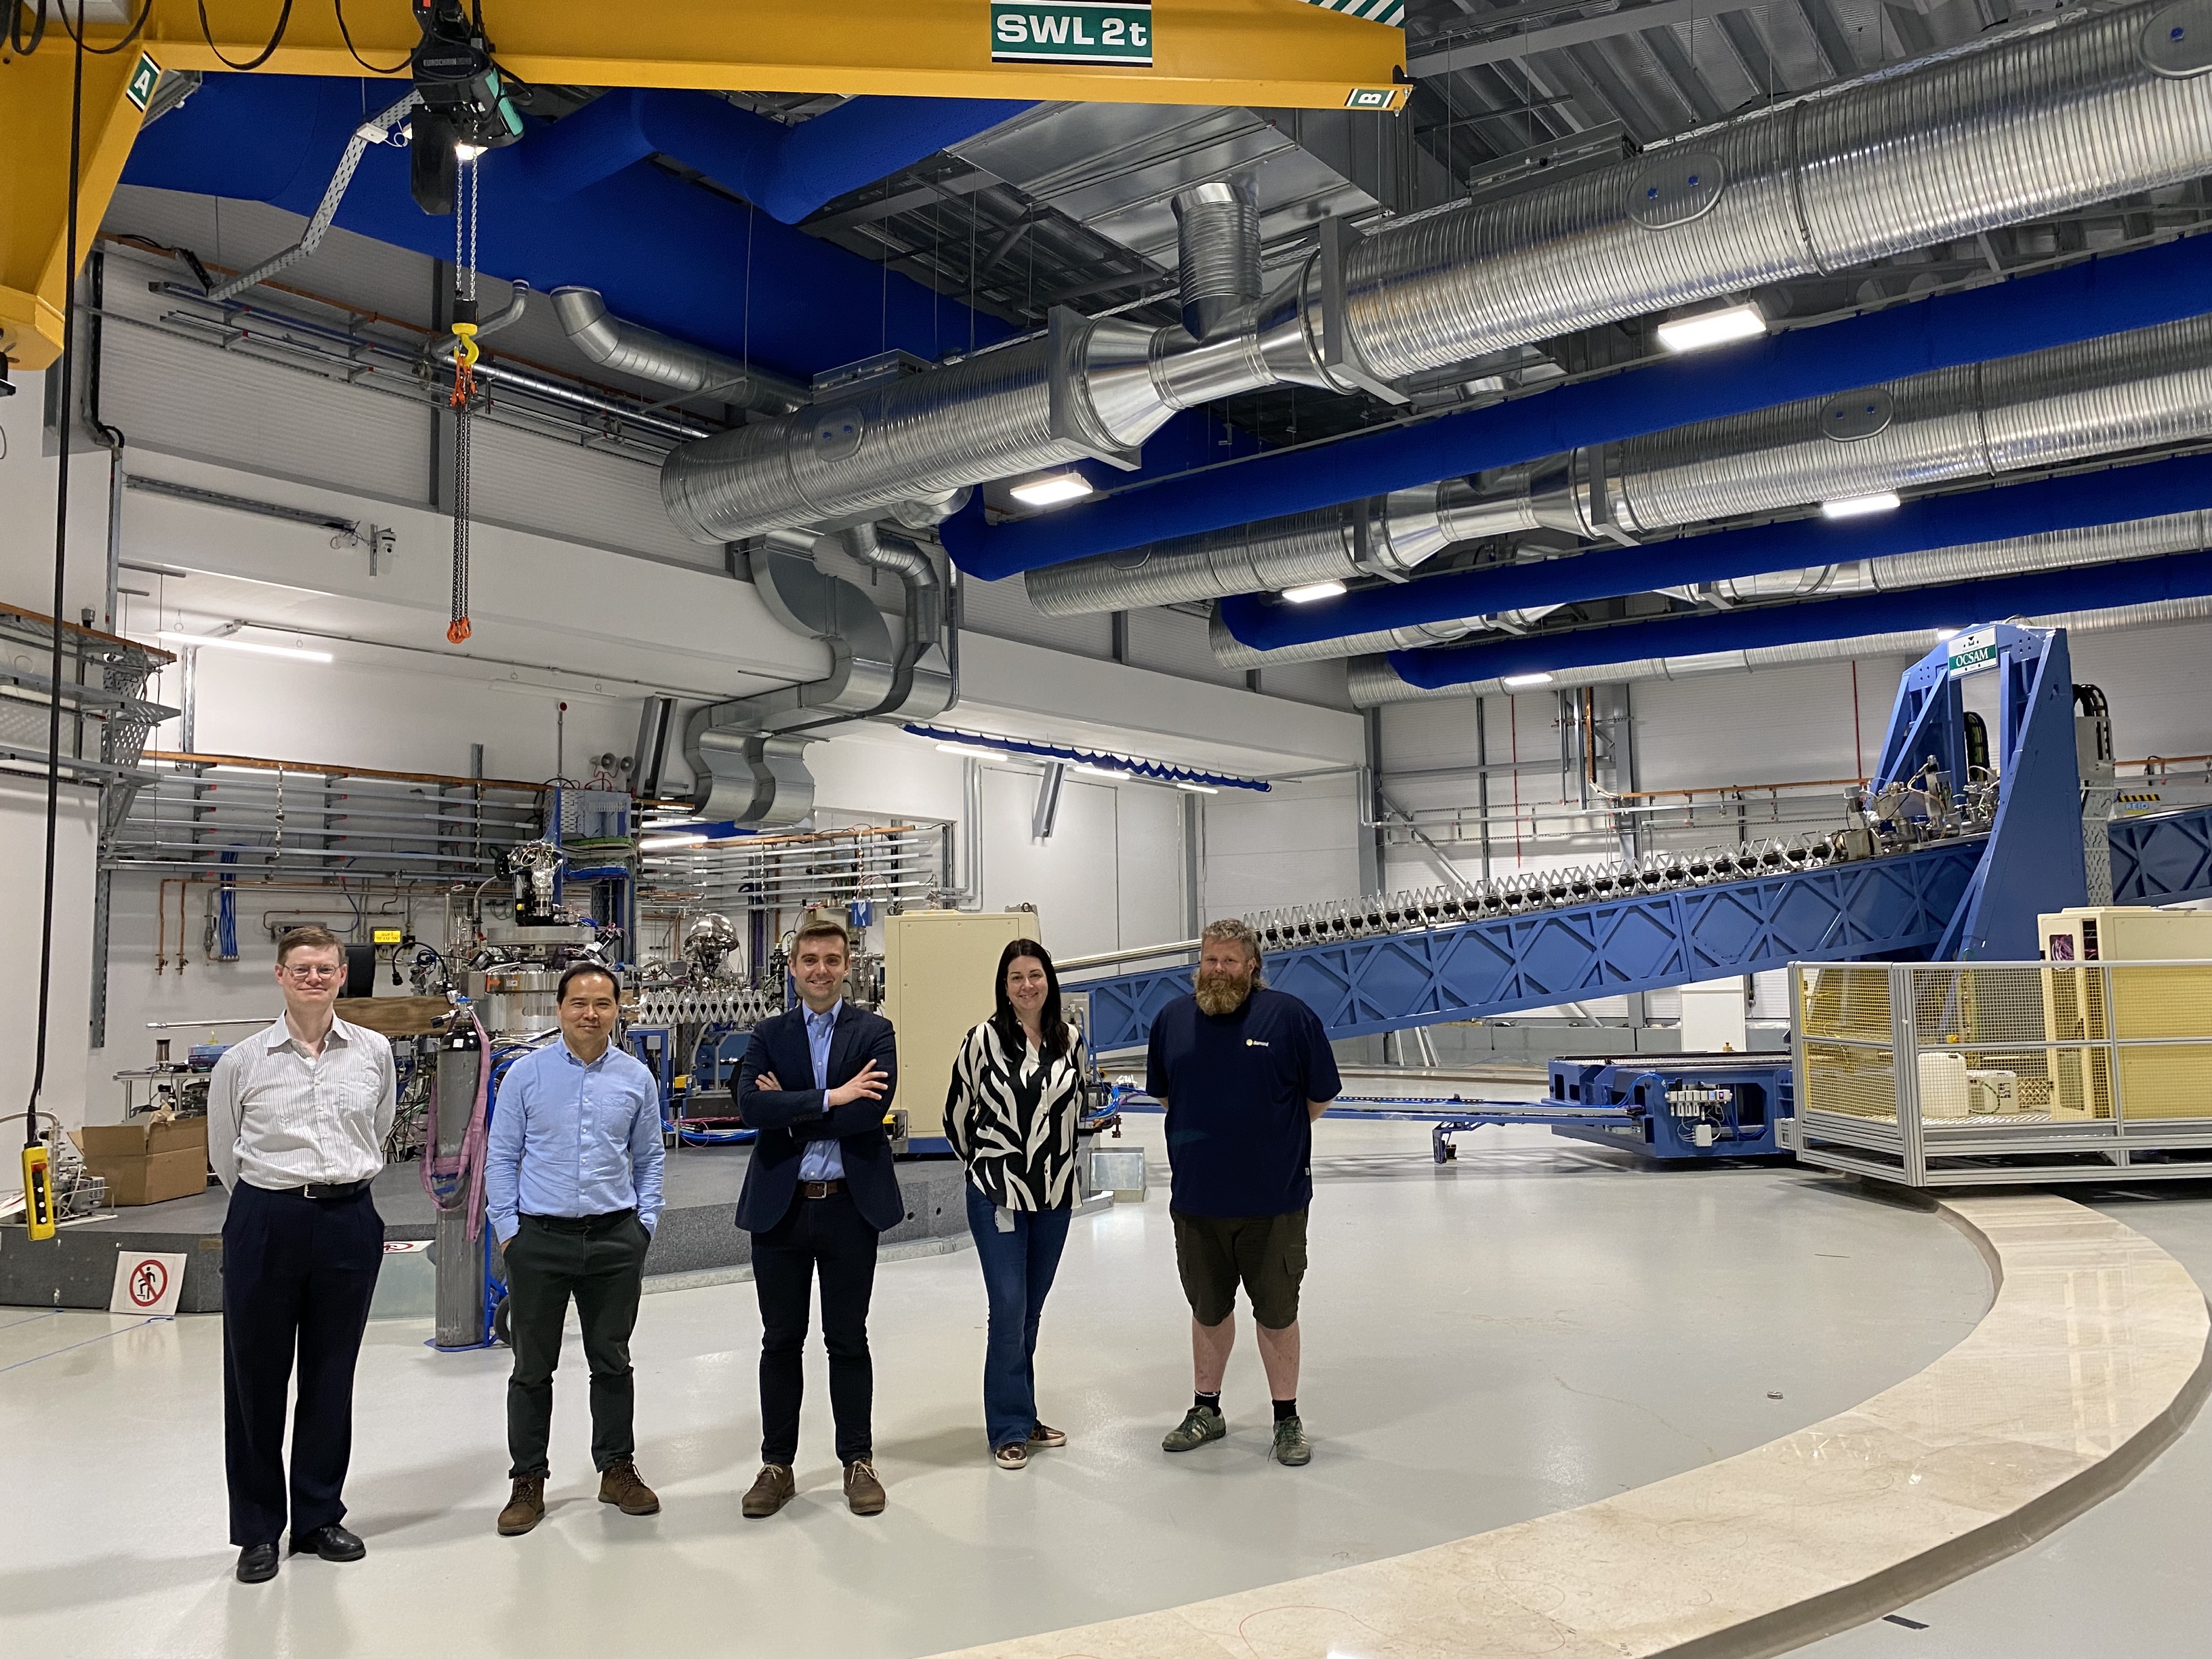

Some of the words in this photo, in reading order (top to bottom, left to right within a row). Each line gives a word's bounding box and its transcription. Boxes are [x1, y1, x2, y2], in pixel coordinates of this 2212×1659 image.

[997, 14, 1094, 45] SWL
[1102, 18, 1147, 47] 2t
[134, 69, 150, 97] A
[1357, 94, 1382, 104] B
[1956, 648, 1988, 667] OCSAM
